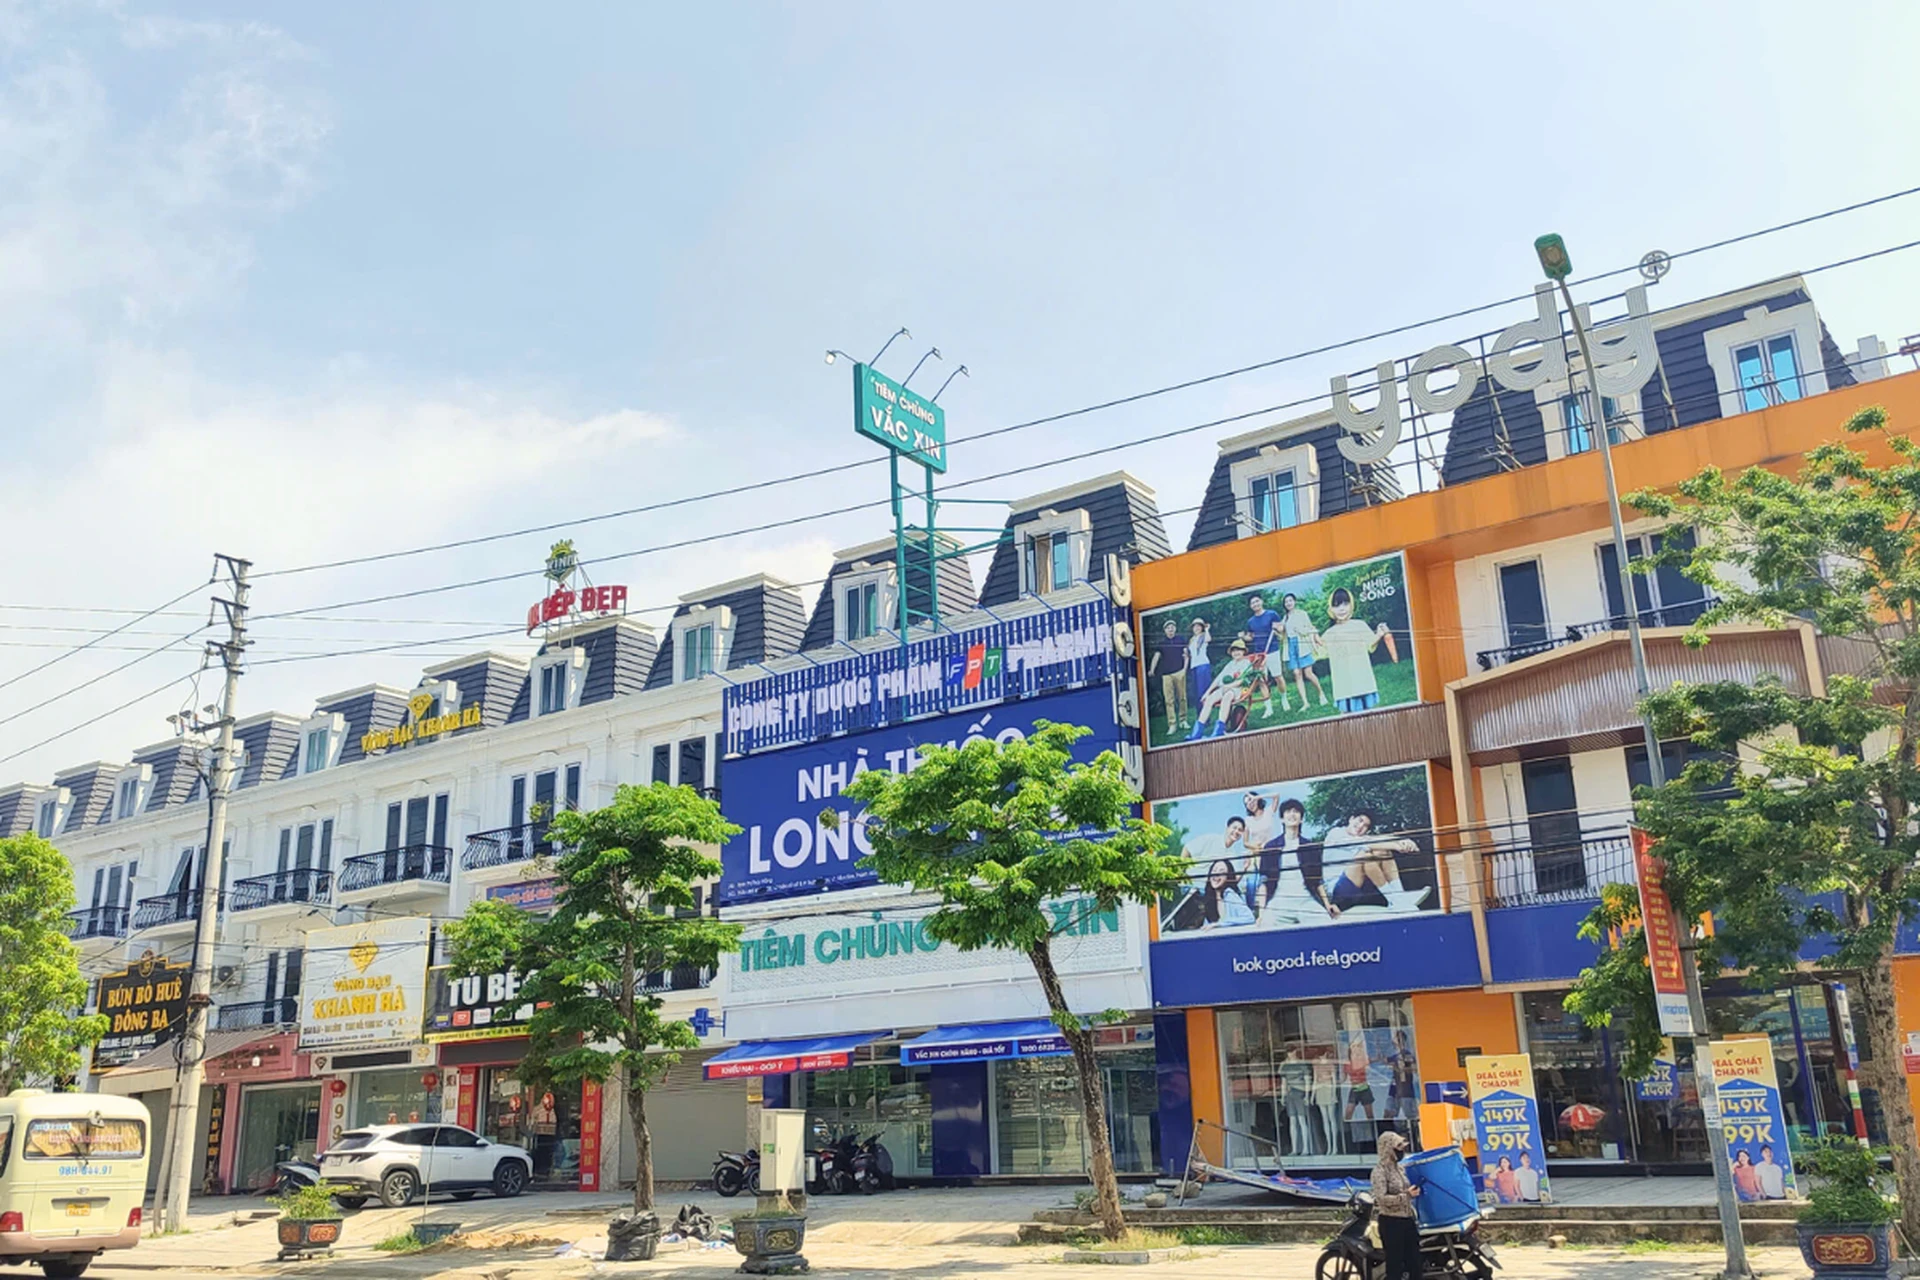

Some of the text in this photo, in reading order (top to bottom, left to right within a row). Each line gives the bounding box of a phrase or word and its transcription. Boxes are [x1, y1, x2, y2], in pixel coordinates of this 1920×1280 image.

[1330, 281, 1659, 464] yody
[874, 380, 936, 426] TIÊM CHỦNG
[870, 404, 941, 461] VẮC XIN
[542, 583, 576, 622] BẾP
[581, 585, 627, 617] ĐẸP
[729, 623, 1113, 732] CÔNG TY DƯỢC PHẨM FPT PHARMA
[797, 748, 871, 802] NHÀ
[1048, 897, 1119, 937] XIN
[739, 911, 941, 973] TIÊM CHỦNG
[1233, 956, 1263, 973] look
[1340, 946, 1381, 969] good
[107, 983, 134, 1008] BÚN
[135, 979, 153, 1005] BÒ
[113, 1008, 169, 1033] ĐÔNG BA
[1483, 1107, 1528, 1124] 149K
[1720, 1097, 1769, 1115] 149K
[1487, 1131, 1533, 1152] 99K
[1723, 1124, 1776, 1145] 99K
